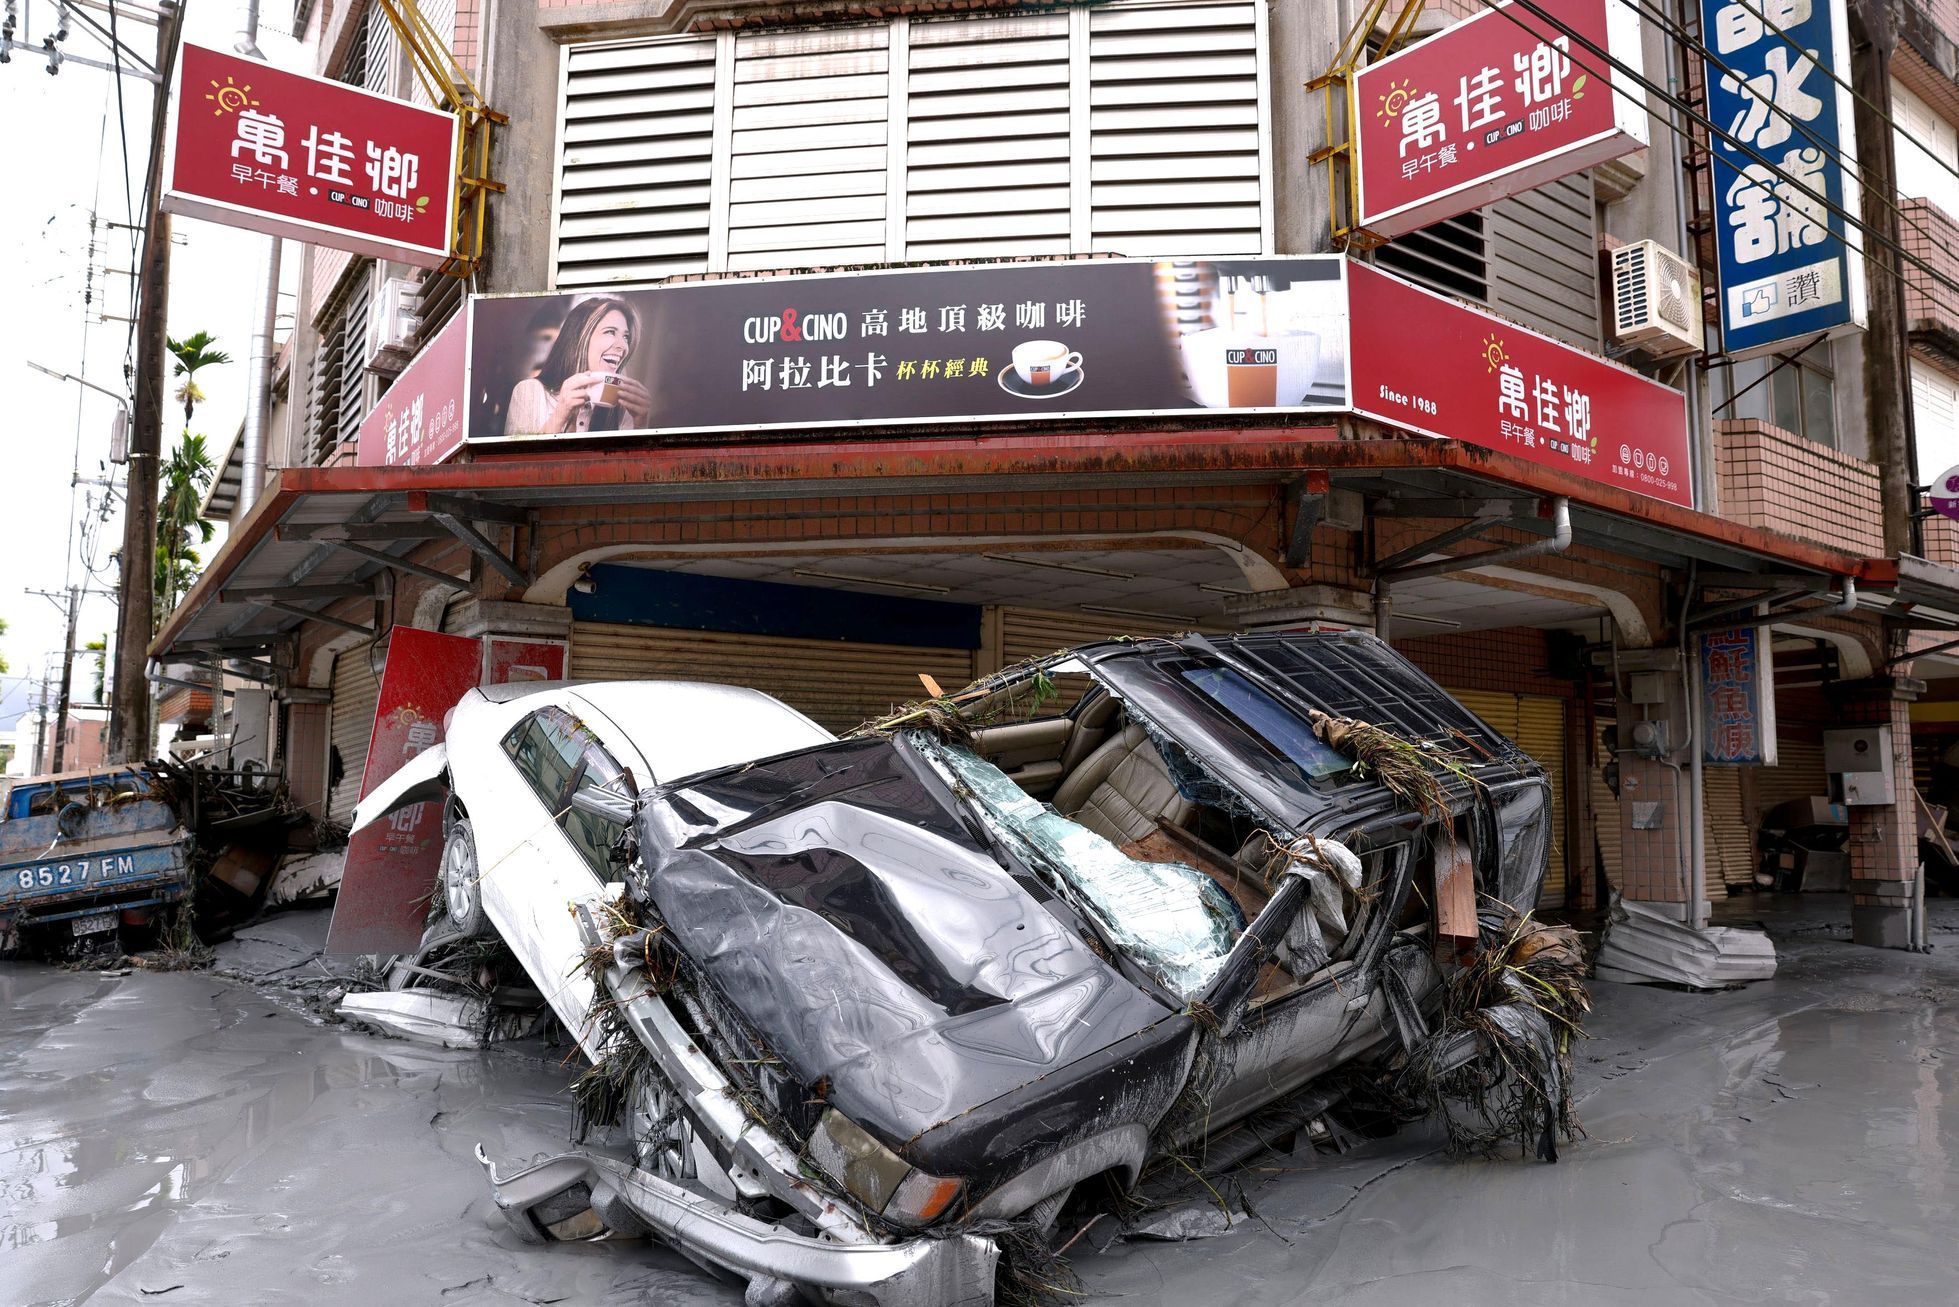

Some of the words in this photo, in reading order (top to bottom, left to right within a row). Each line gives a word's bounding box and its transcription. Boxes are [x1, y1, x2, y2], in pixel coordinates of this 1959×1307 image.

[1399, 35, 1571, 158] 萬佳鄉
[231, 109, 419, 199] 萬佳鄉
[1402, 143, 1457, 181] 早午餐
[1529, 98, 1573, 132] 咖啡
[231, 163, 298, 197] 早午餐
[375, 198, 414, 223] 咖啡
[743, 306, 848, 344] CUP&CINO
[861, 300, 1086, 338] 高地頂級咖啡
[742, 352, 888, 392] 阿拉比卡
[896, 357, 989, 380] 杯杯經典
[1228, 348, 1275, 364] CUP&CINO
[1380, 385, 1408, 405] Since
[1412, 396, 1437, 415] 1988
[1499, 363, 1591, 441] 萬佳鄉
[1501, 420, 1535, 447] 早午餐
[1571, 443, 1591, 464] 咖啡
[19, 861, 90, 889] 8527
[101, 856, 134, 878] FM
